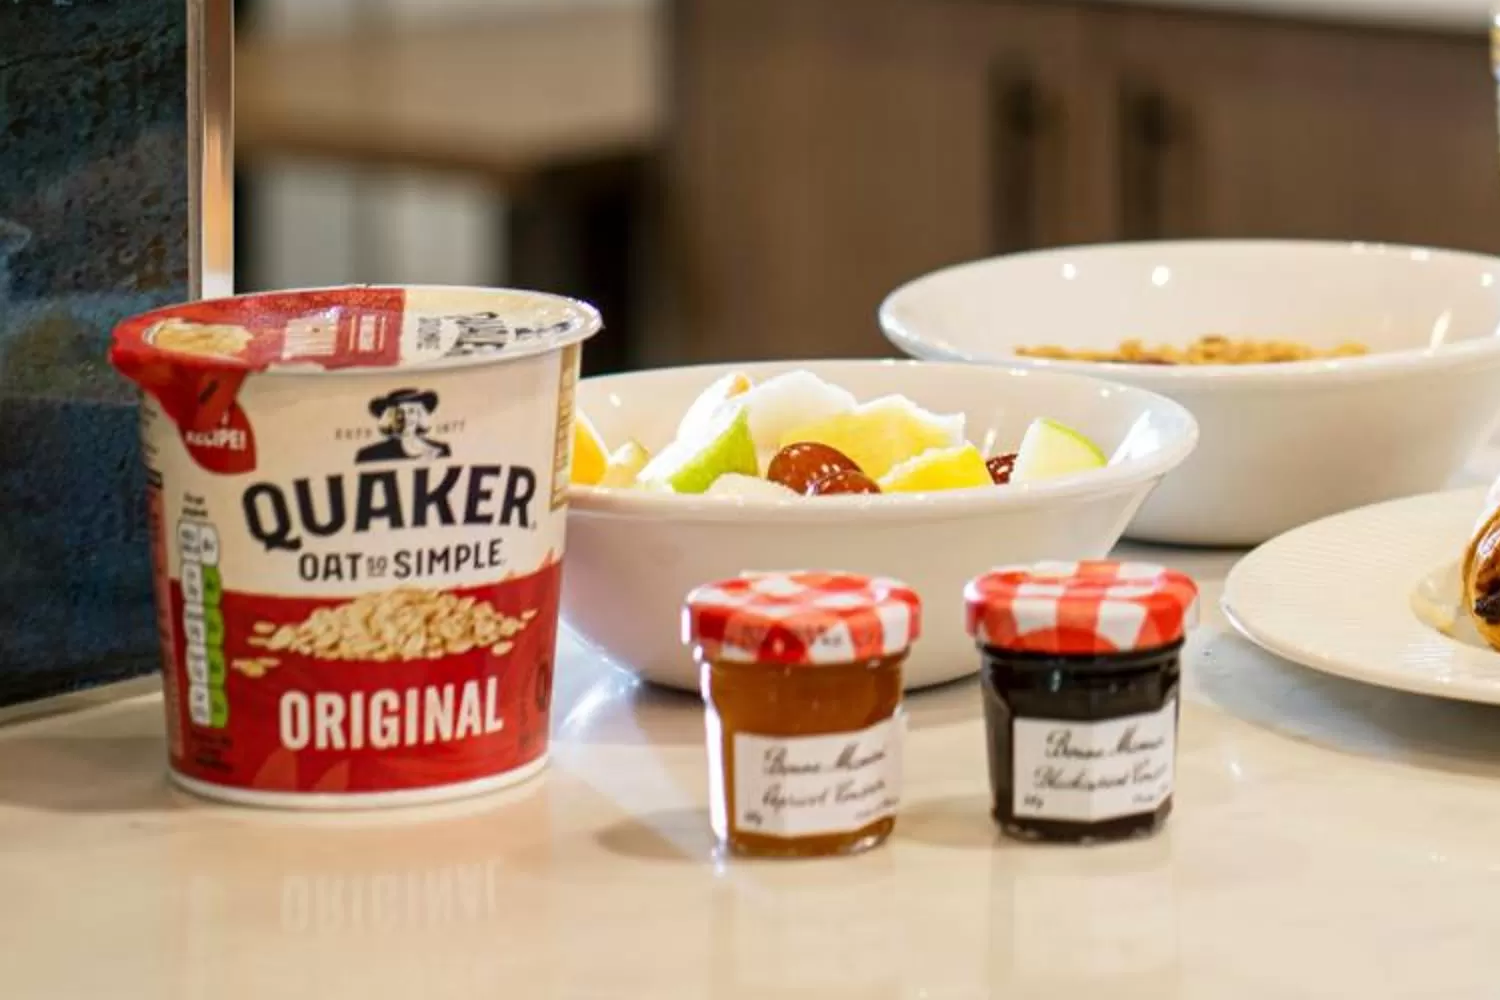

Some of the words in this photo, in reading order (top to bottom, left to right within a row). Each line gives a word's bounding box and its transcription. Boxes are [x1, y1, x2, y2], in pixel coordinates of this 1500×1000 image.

[243, 464, 535, 552] QUAKER
[299, 552, 363, 582] OAT
[393, 538, 503, 579] SIMPLE
[279, 677, 504, 752] ORIGINAL
